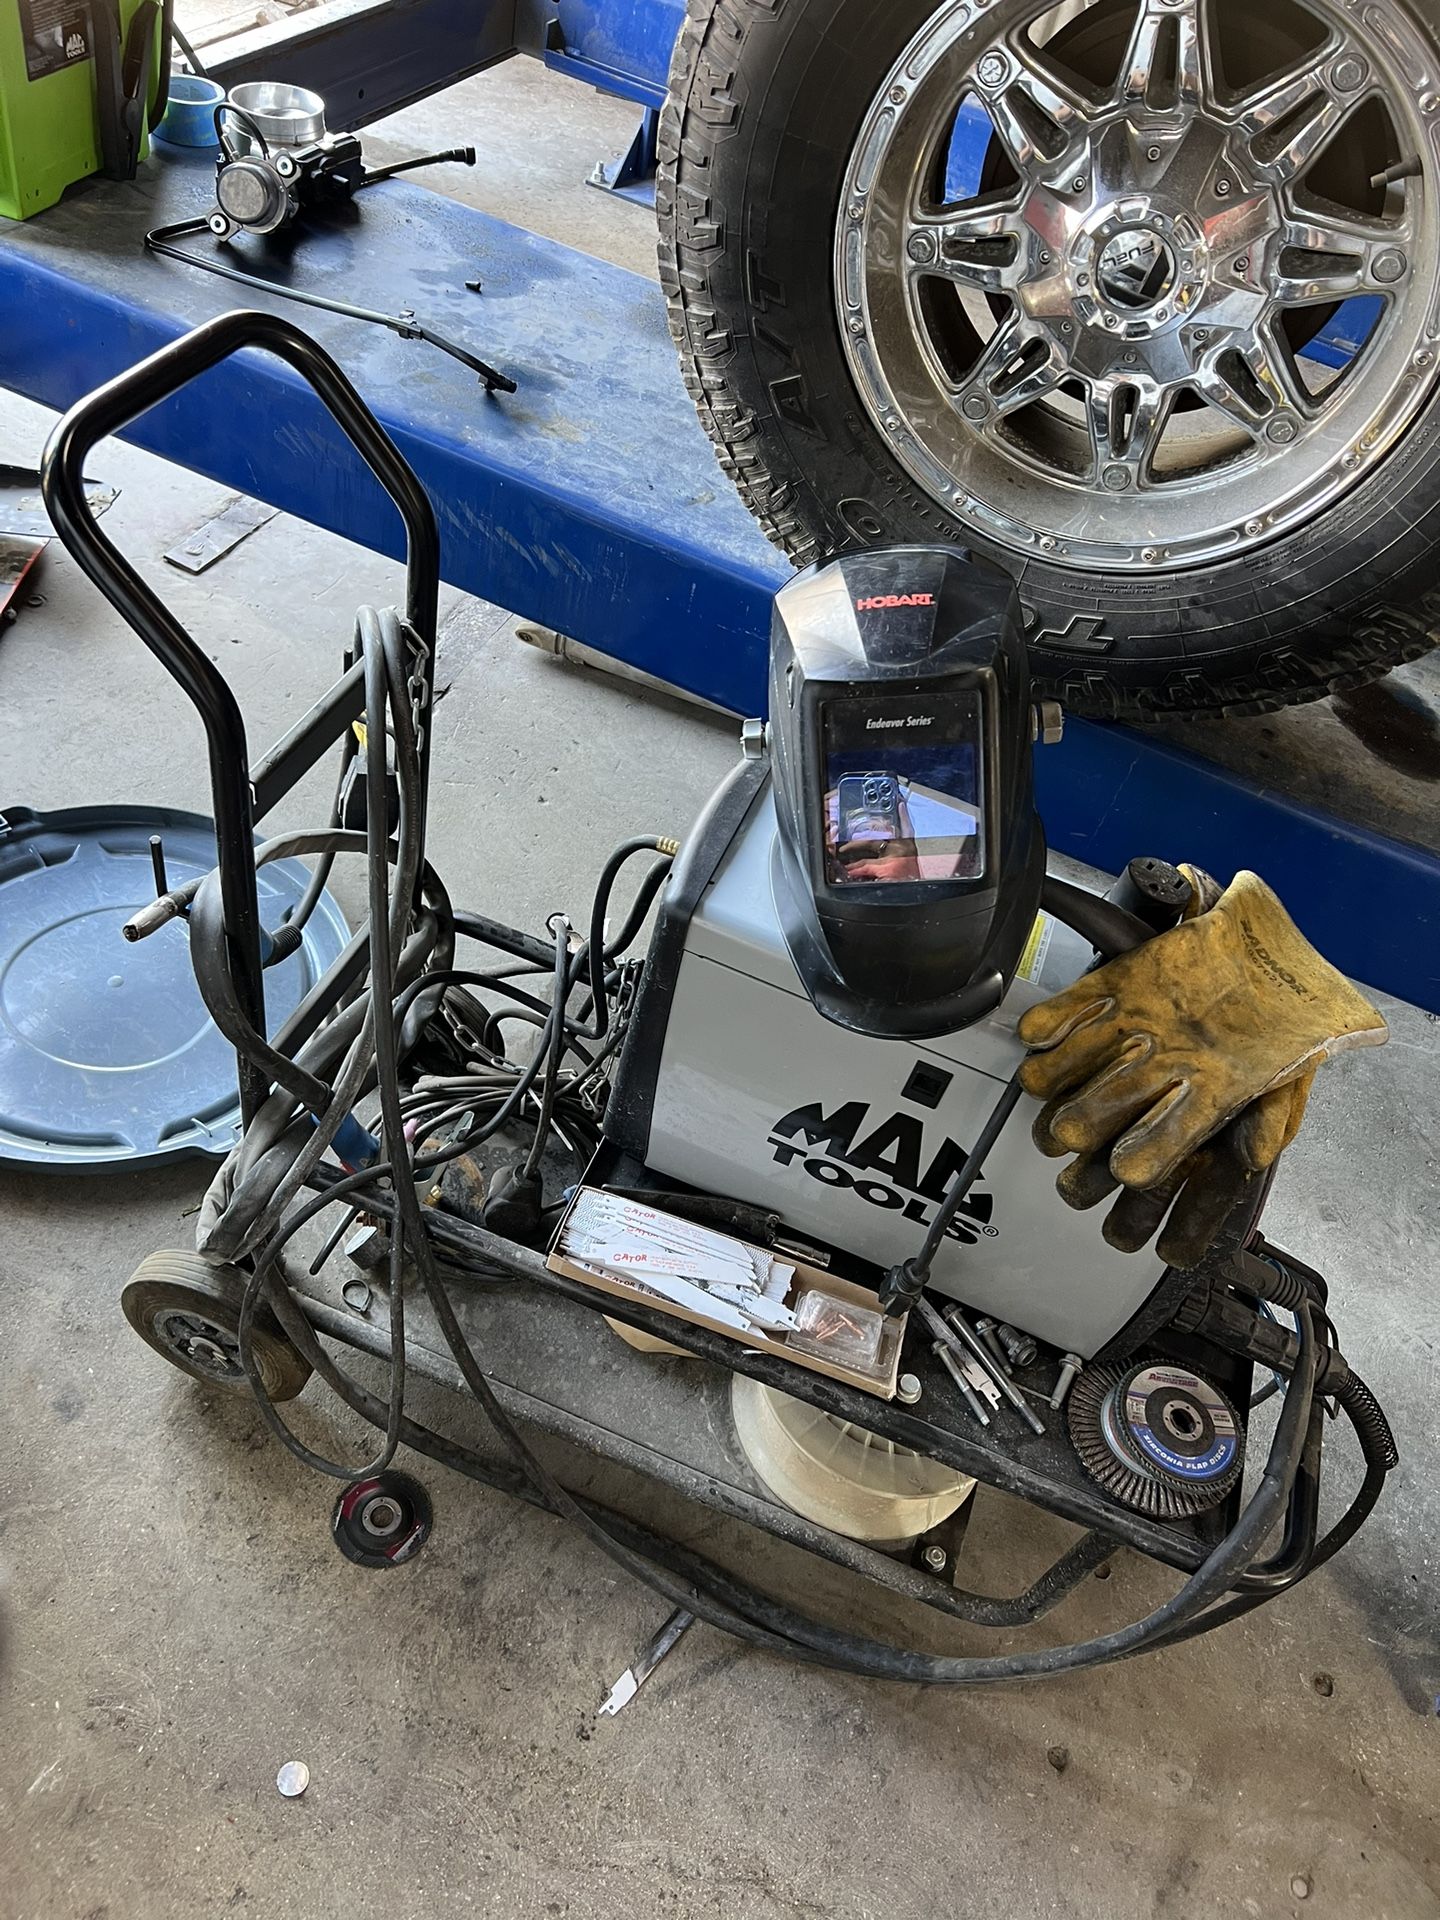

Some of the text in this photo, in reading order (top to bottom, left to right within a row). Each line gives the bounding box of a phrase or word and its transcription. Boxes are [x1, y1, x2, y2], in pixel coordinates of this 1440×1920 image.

[1103, 240, 1154, 266] FUEL
[857, 593, 933, 611] HOBART
[866, 717, 905, 729] Endeavor
[1240, 919, 1308, 996] RADNOR
[771, 1101, 993, 1225] MAC
[623, 1206, 656, 1219] GATOR
[613, 1253, 648, 1264] GATOR
[1142, 1434, 1226, 1470] ZIRCONIA FLAP DISCS
